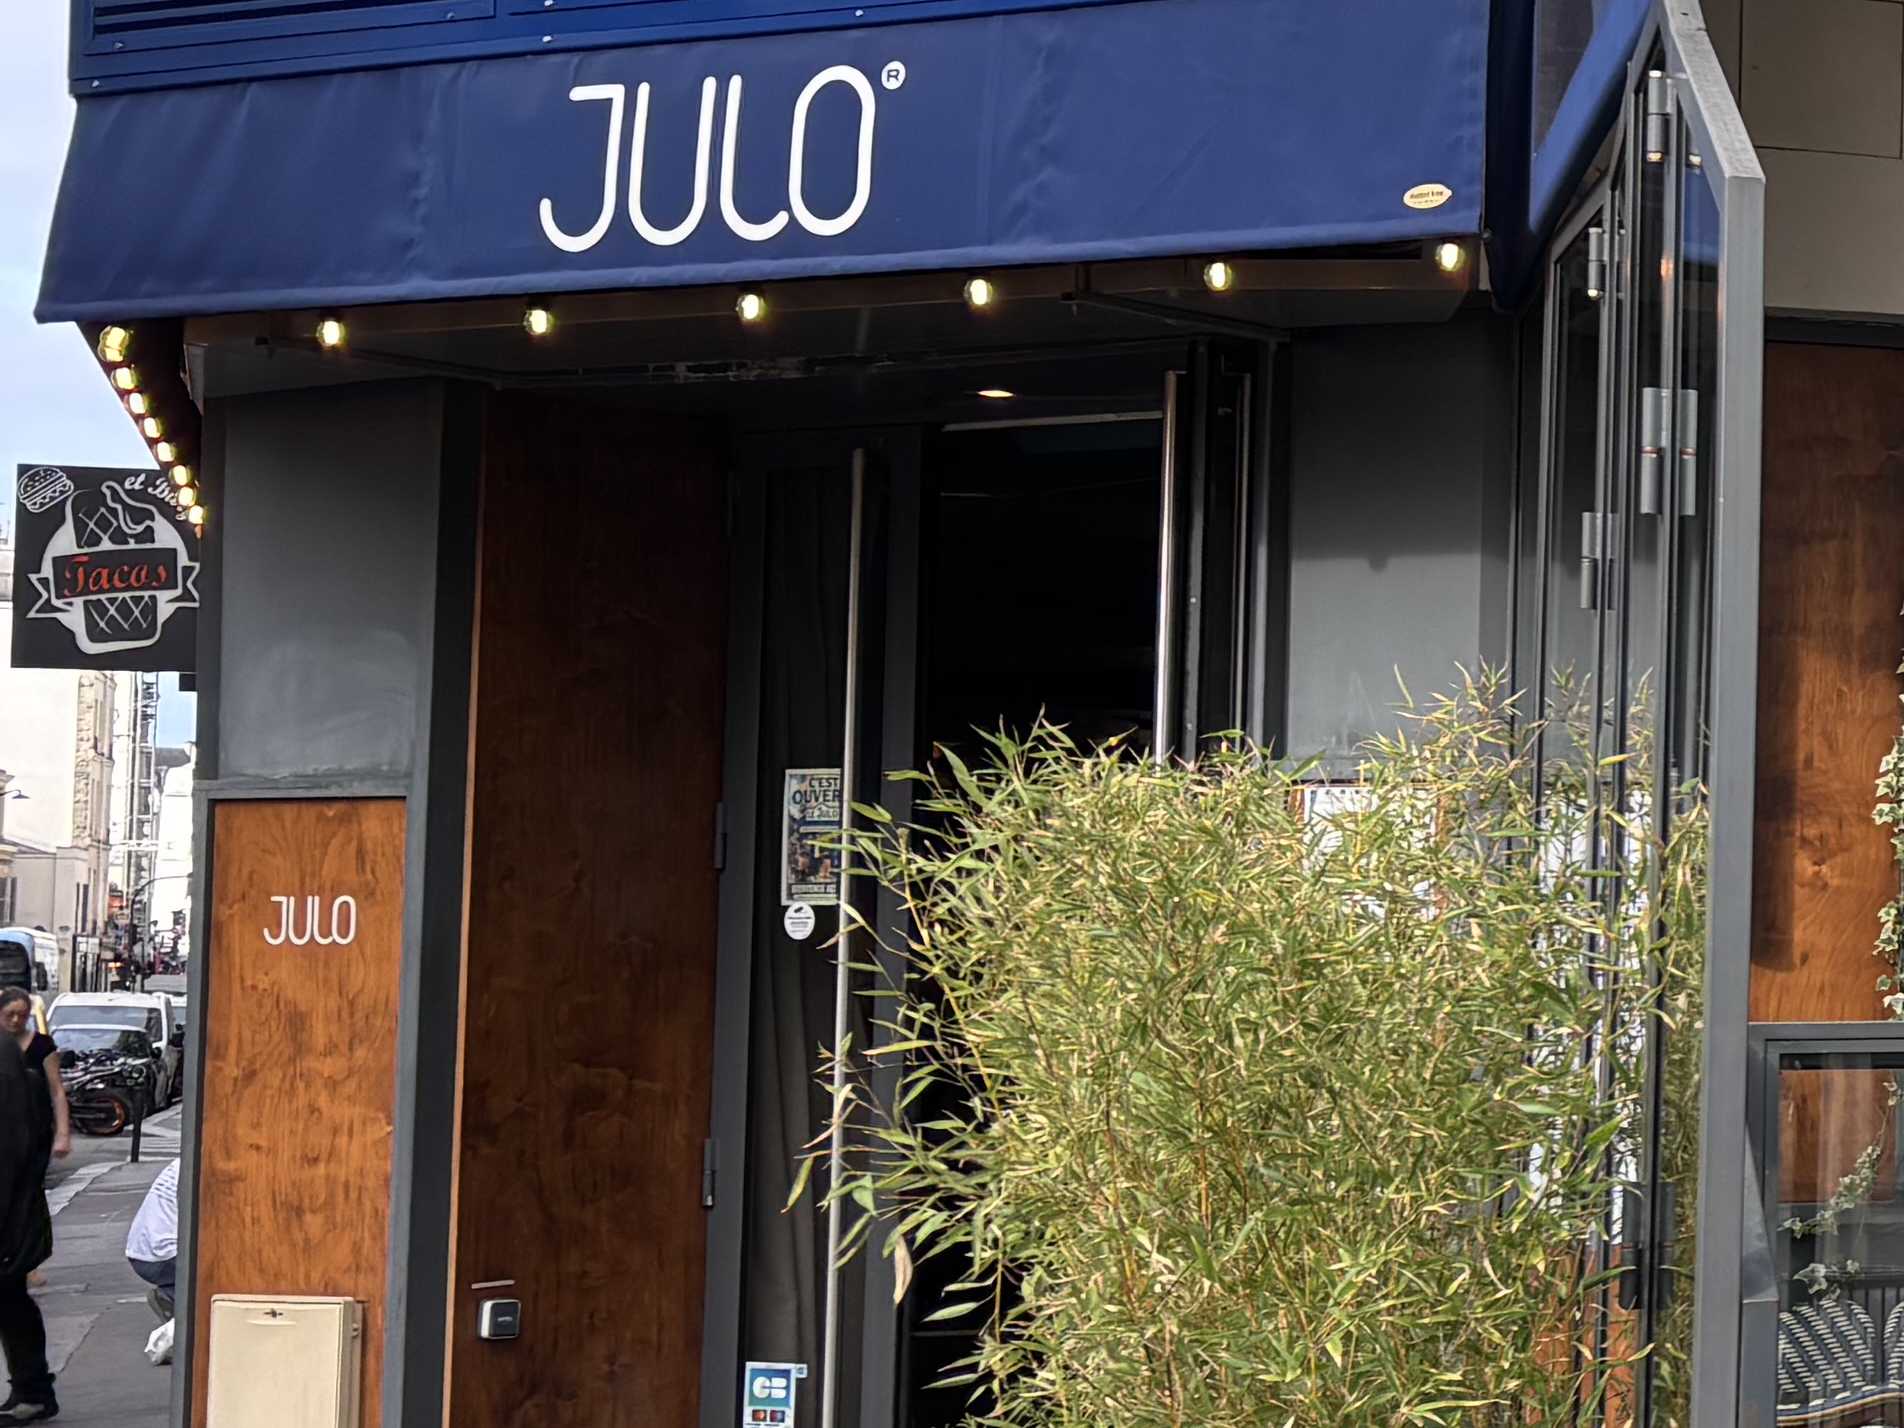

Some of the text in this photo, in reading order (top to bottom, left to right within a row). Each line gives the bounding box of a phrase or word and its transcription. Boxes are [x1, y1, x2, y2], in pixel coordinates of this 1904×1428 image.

[540, 65, 876, 253] JULO
[64, 555, 167, 598] Tacos
[263, 895, 356, 945] JULO
